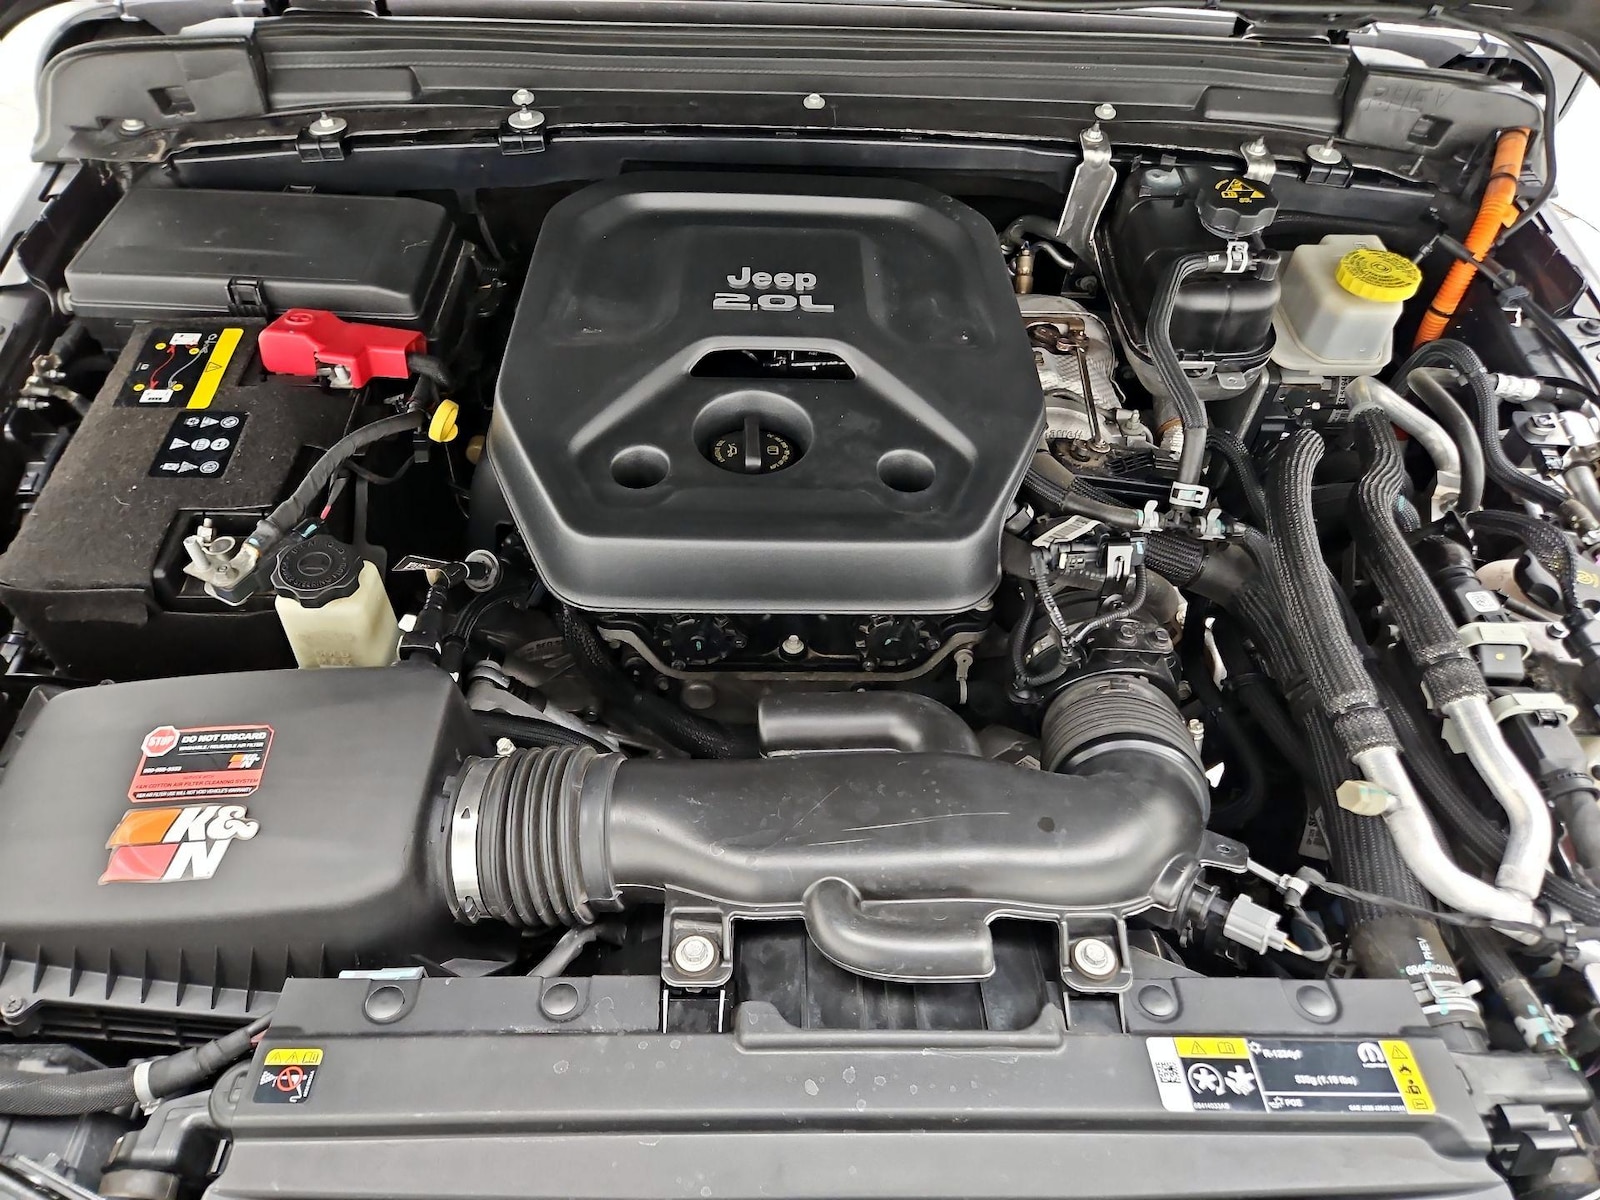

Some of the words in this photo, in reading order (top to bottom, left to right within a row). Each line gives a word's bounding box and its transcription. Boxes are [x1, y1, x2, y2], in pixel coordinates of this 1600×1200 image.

[726, 266, 817, 294] Jeep
[712, 292, 835, 312] 2.0L
[147, 735, 175, 747] STOP
[181, 735, 198, 743] DO
[198, 734, 221, 742] NOT
[221, 732, 267, 741] DISCARD
[1416, 937, 1434, 961] PHEV
